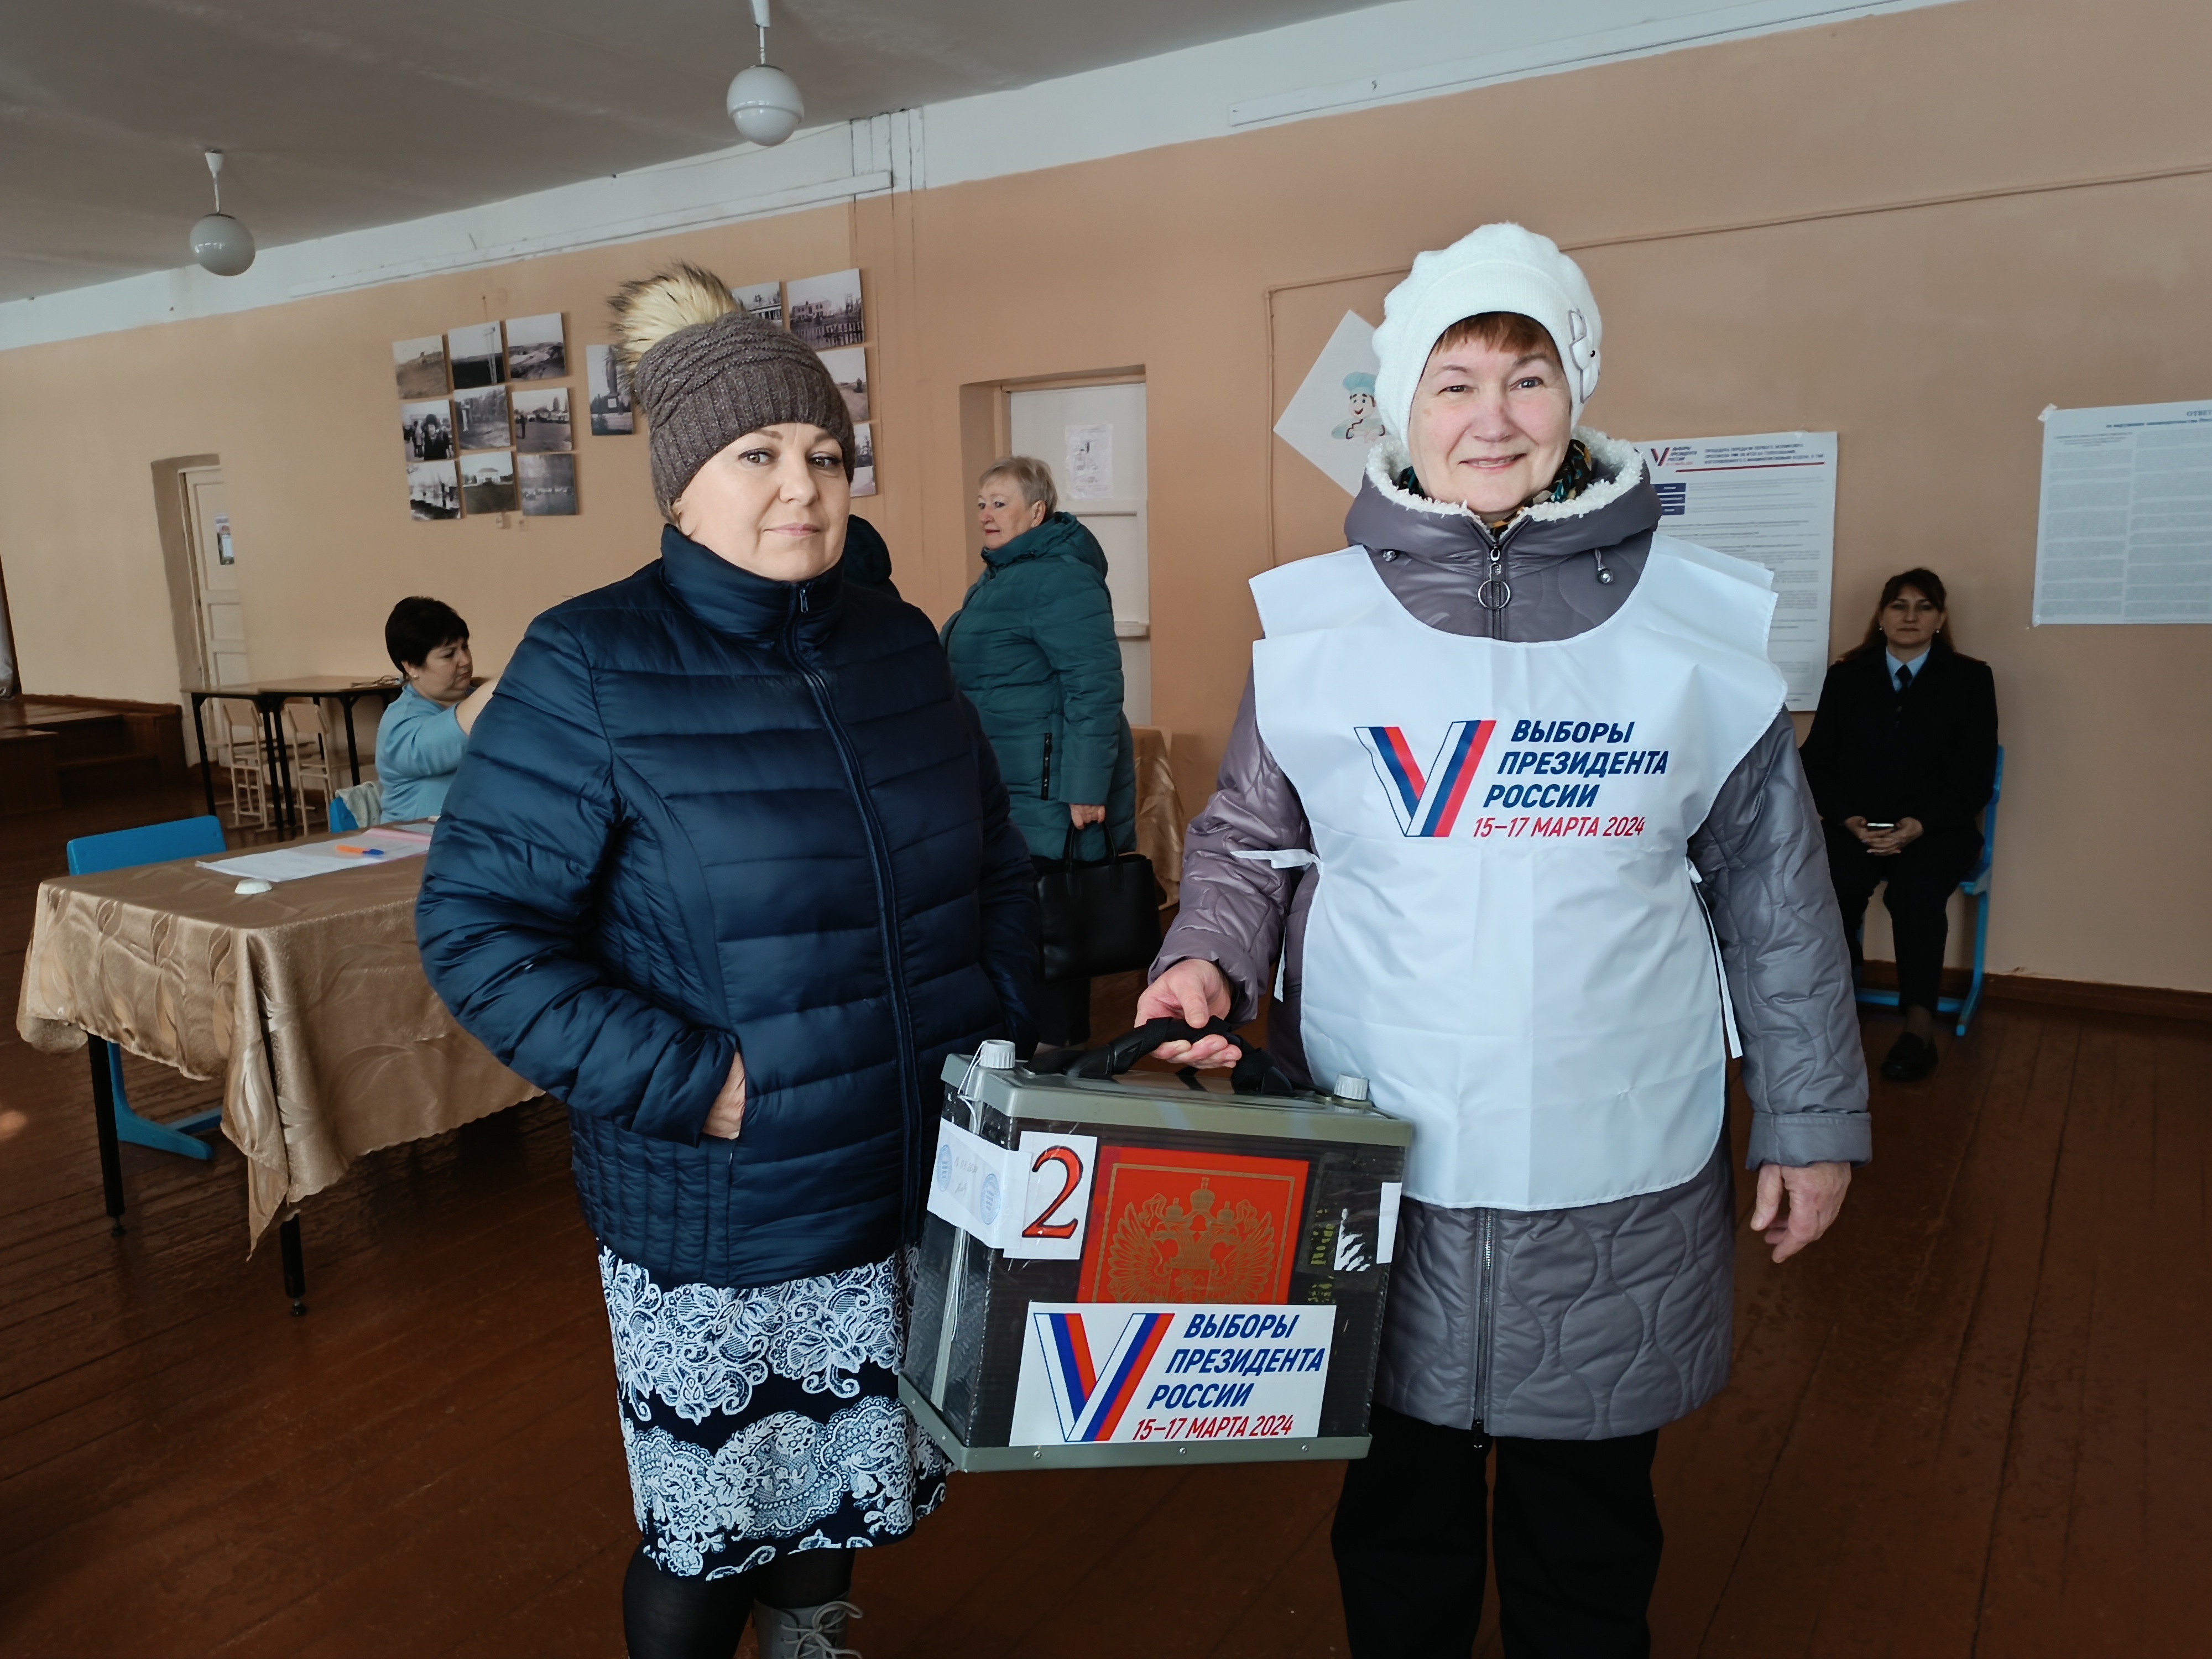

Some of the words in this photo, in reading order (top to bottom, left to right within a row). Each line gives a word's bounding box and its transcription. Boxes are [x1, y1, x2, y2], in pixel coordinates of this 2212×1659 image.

[1511, 719, 1635, 743] ВЫБОРЫ
[1497, 751, 1669, 778] ПРЕЗИДЕНТА
[1483, 784, 1600, 808] РОССИИ
[1531, 817, 1601, 838] МАРТА
[1603, 816, 1646, 837] 2024
[1021, 1145, 1084, 1239] 2
[1183, 1313, 1300, 1338] ВЫБОРЫ
[1165, 1348, 1326, 1376] ПРЕЗИДЕНТА
[1146, 1383, 1255, 1410] РОССИИ
[1185, 1416, 1249, 1439] МАРТА
[1249, 1414, 1294, 1437] 2024
